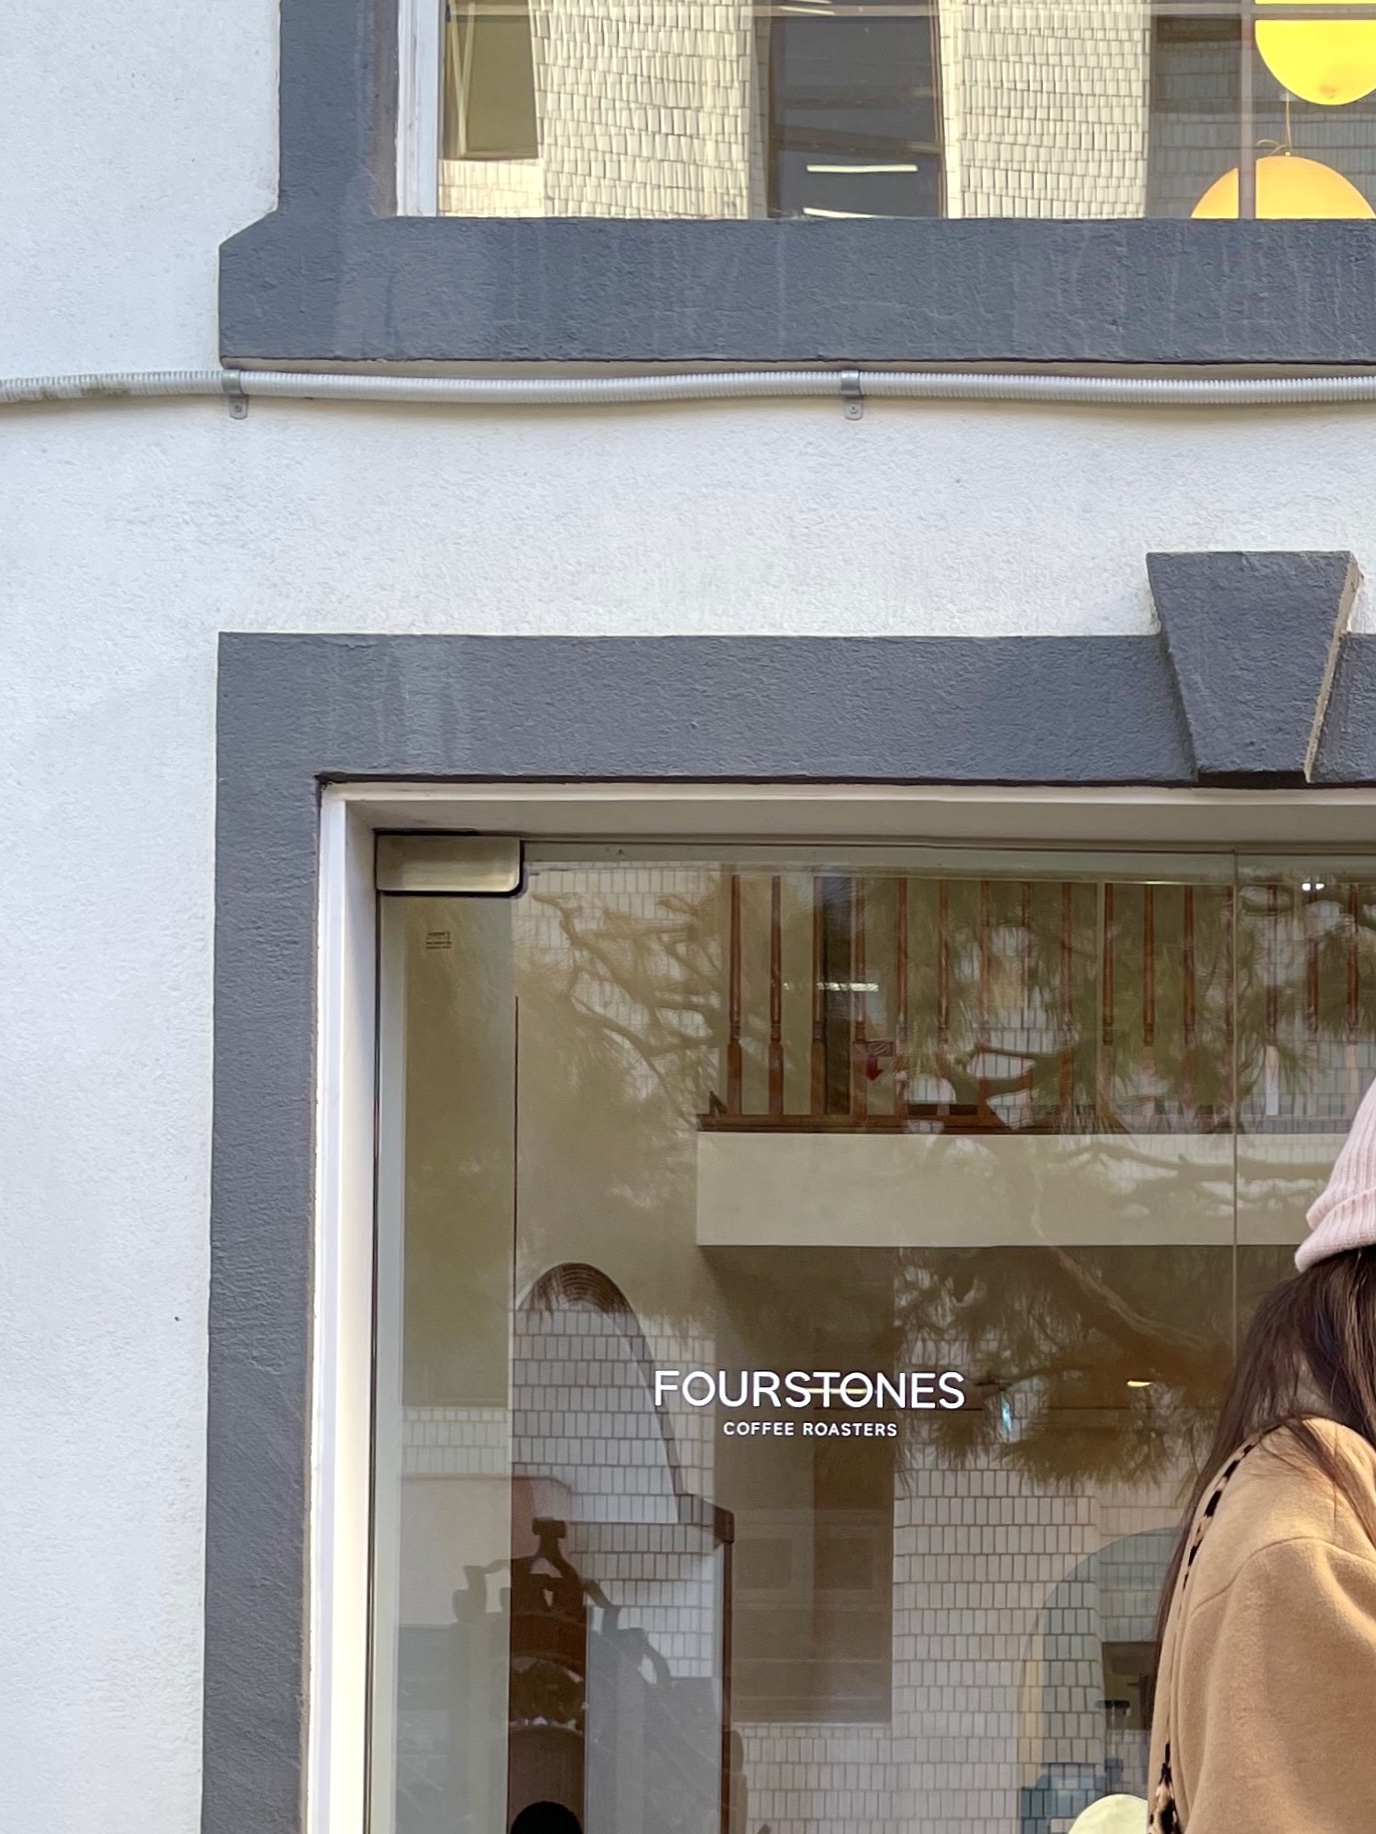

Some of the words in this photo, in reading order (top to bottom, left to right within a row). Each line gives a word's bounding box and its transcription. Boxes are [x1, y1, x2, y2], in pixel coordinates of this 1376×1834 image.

[654, 1370, 965, 1409] FOURSTONES
[723, 1421, 794, 1436] COFFEE
[803, 1422, 897, 1437] ROASTERS
